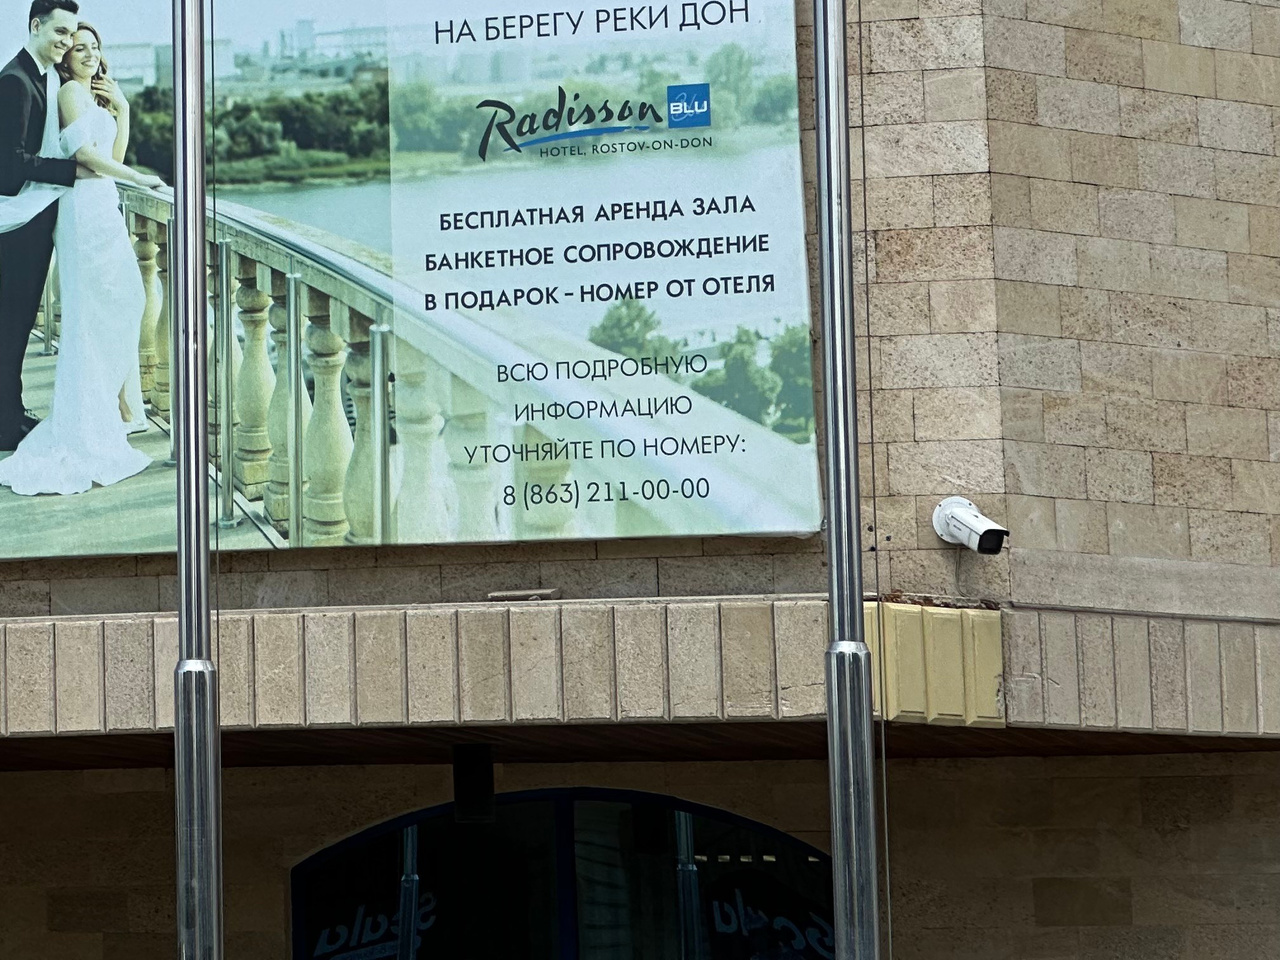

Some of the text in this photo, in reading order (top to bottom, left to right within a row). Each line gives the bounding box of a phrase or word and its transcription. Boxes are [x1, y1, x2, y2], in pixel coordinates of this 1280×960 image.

[434, 18, 477, 45] НА
[484, 10, 585, 41] БЕРЕГУ
[595, 4, 669, 34] РЕКИ
[475, 85, 708, 162] Radisson BLU
[539, 136, 713, 158] HOTEL, ROSTOV-ON-DON
[439, 194, 756, 231] БЕСПЛАТНАЯ АРЕНДА ЗАЛА
[424, 233, 770, 272] БАНКЕТНОЕ СОПРОВОЖДЕНИЕ
[424, 292, 437, 311] В
[444, 286, 560, 312] ПОДАРОК
[579, 281, 659, 303] НОМЕР
[665, 278, 696, 298] ОТ
[702, 273, 776, 296] ОТЕЛЯ
[497, 353, 708, 383] ВСЮ ПОДРОБНУЮ
[514, 395, 693, 422] ИНФОРМАЦИЮ
[464, 434, 747, 465] УТОЧНЯЙТЕ ПО НОМЕРУ:
[503, 477, 711, 511] 8 (863) 211-00-00
